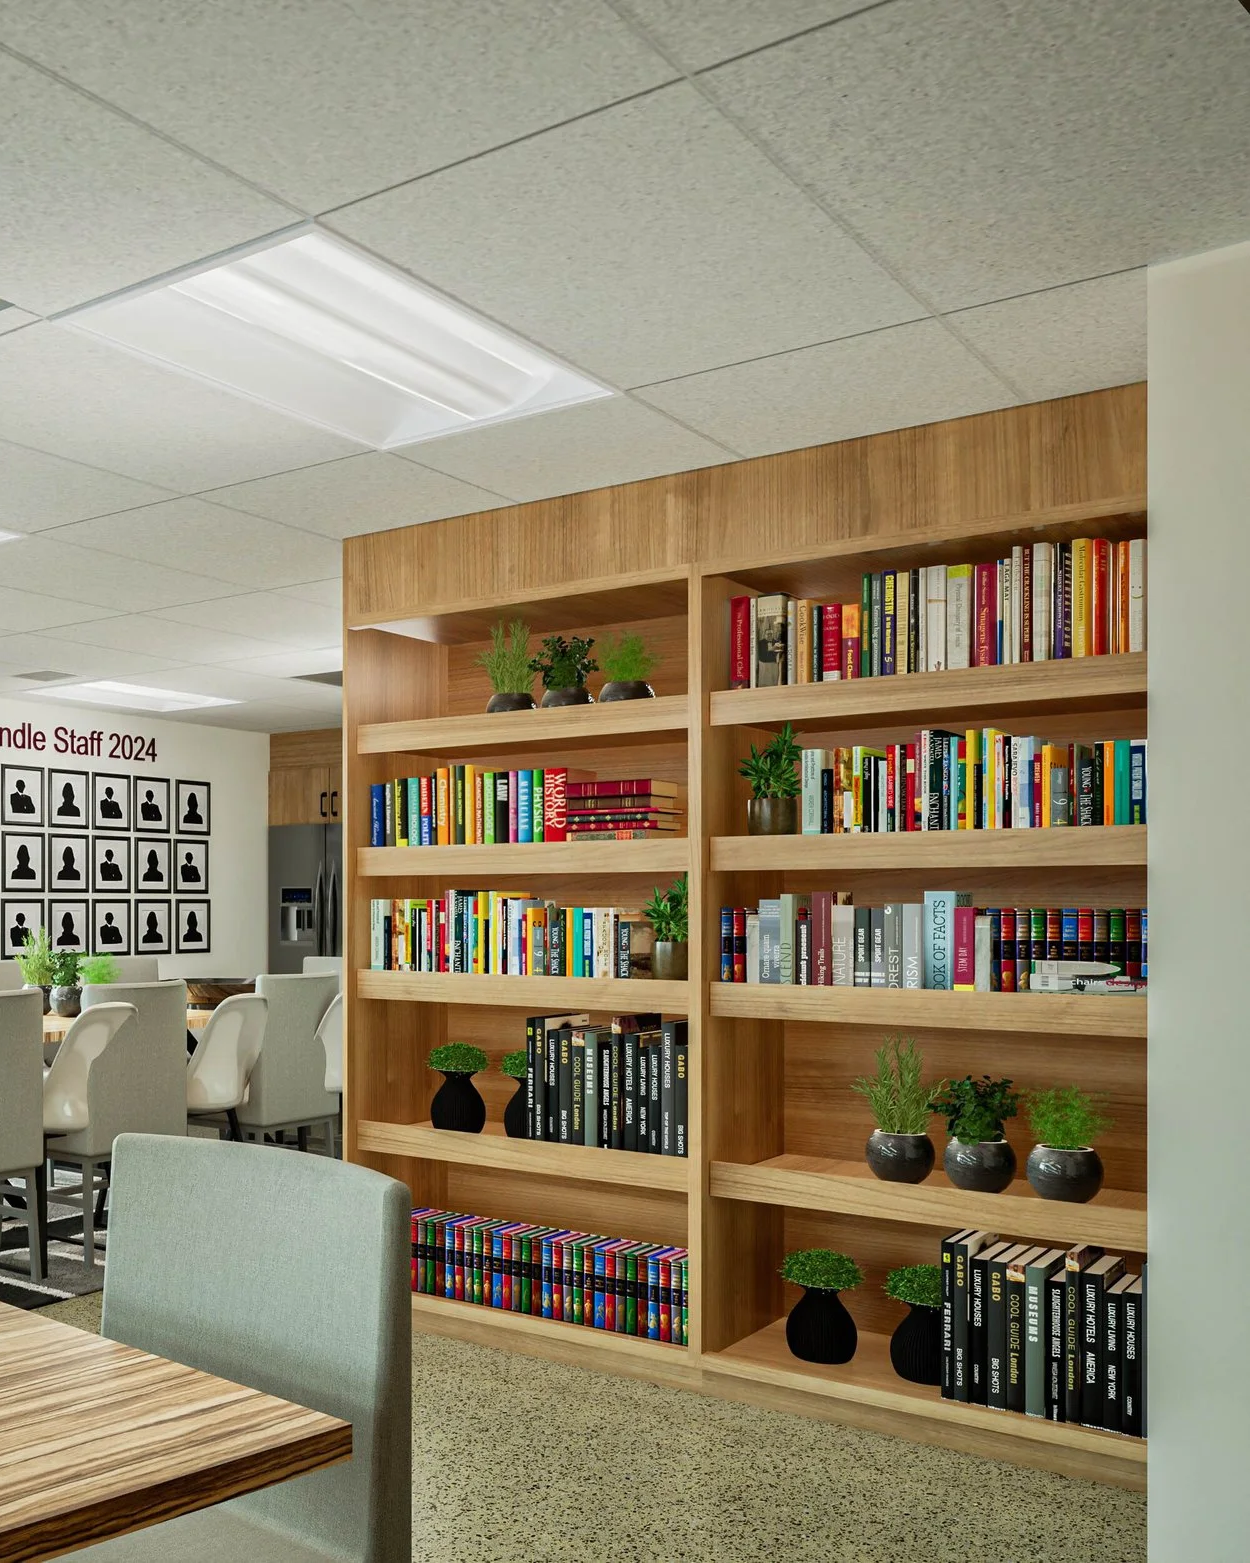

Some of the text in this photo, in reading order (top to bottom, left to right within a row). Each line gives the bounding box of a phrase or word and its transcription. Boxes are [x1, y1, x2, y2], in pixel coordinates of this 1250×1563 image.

[1078, 545, 1086, 579] Molecular
[885, 575, 894, 615] CHEMISTRY
[978, 607, 989, 643] Smagens
[53, 726, 104, 757] Staff
[108, 733, 158, 763] 2024
[934, 737, 942, 759] JAMES
[421, 777, 429, 814] MODERN
[438, 779, 447, 826] Chemistry
[497, 779, 508, 801] LAW
[520, 780, 529, 830] MEDICINE
[545, 774, 556, 828] HISTORY
[554, 773, 567, 828] WORLD
[1080, 766, 1093, 826] YOUNG THE SHACK
[534, 787, 543, 833] PHYSICS
[551, 927, 559, 944] YOUNG
[620, 928, 629, 946] YOUNG
[933, 900, 946, 941] FACTS
[620, 950, 630, 960] THE
[762, 935, 771, 978] Ornare quam
[800, 925, 808, 960] praesent
[832, 937, 846, 984] NATURE
[933, 944, 946, 961] OF
[906, 956, 918, 988] RISM
[958, 957, 968, 973] STEM
[992, 1272, 1000, 1302] GABO
[943, 1301, 951, 1351] FERRARI
[973, 1297, 981, 1327] HOUSES
[1028, 1285, 1038, 1343] MUSEUMS
[1051, 1288, 1061, 1336] SLAUGHTERHOUSE
[1127, 1303, 1135, 1330] LUXURY
[1010, 1294, 1020, 1384] COOL GUIDE London
[1052, 1337, 1061, 1358] ANGELS
[1086, 1284, 1096, 1384] LUXURY HOTELS AMERICA
[1107, 1303, 1116, 1400] LUXURY LIVING NEW YORK
[1126, 1331, 1135, 1359] HOUSES
[991, 1370, 1000, 1394] SHOTS
